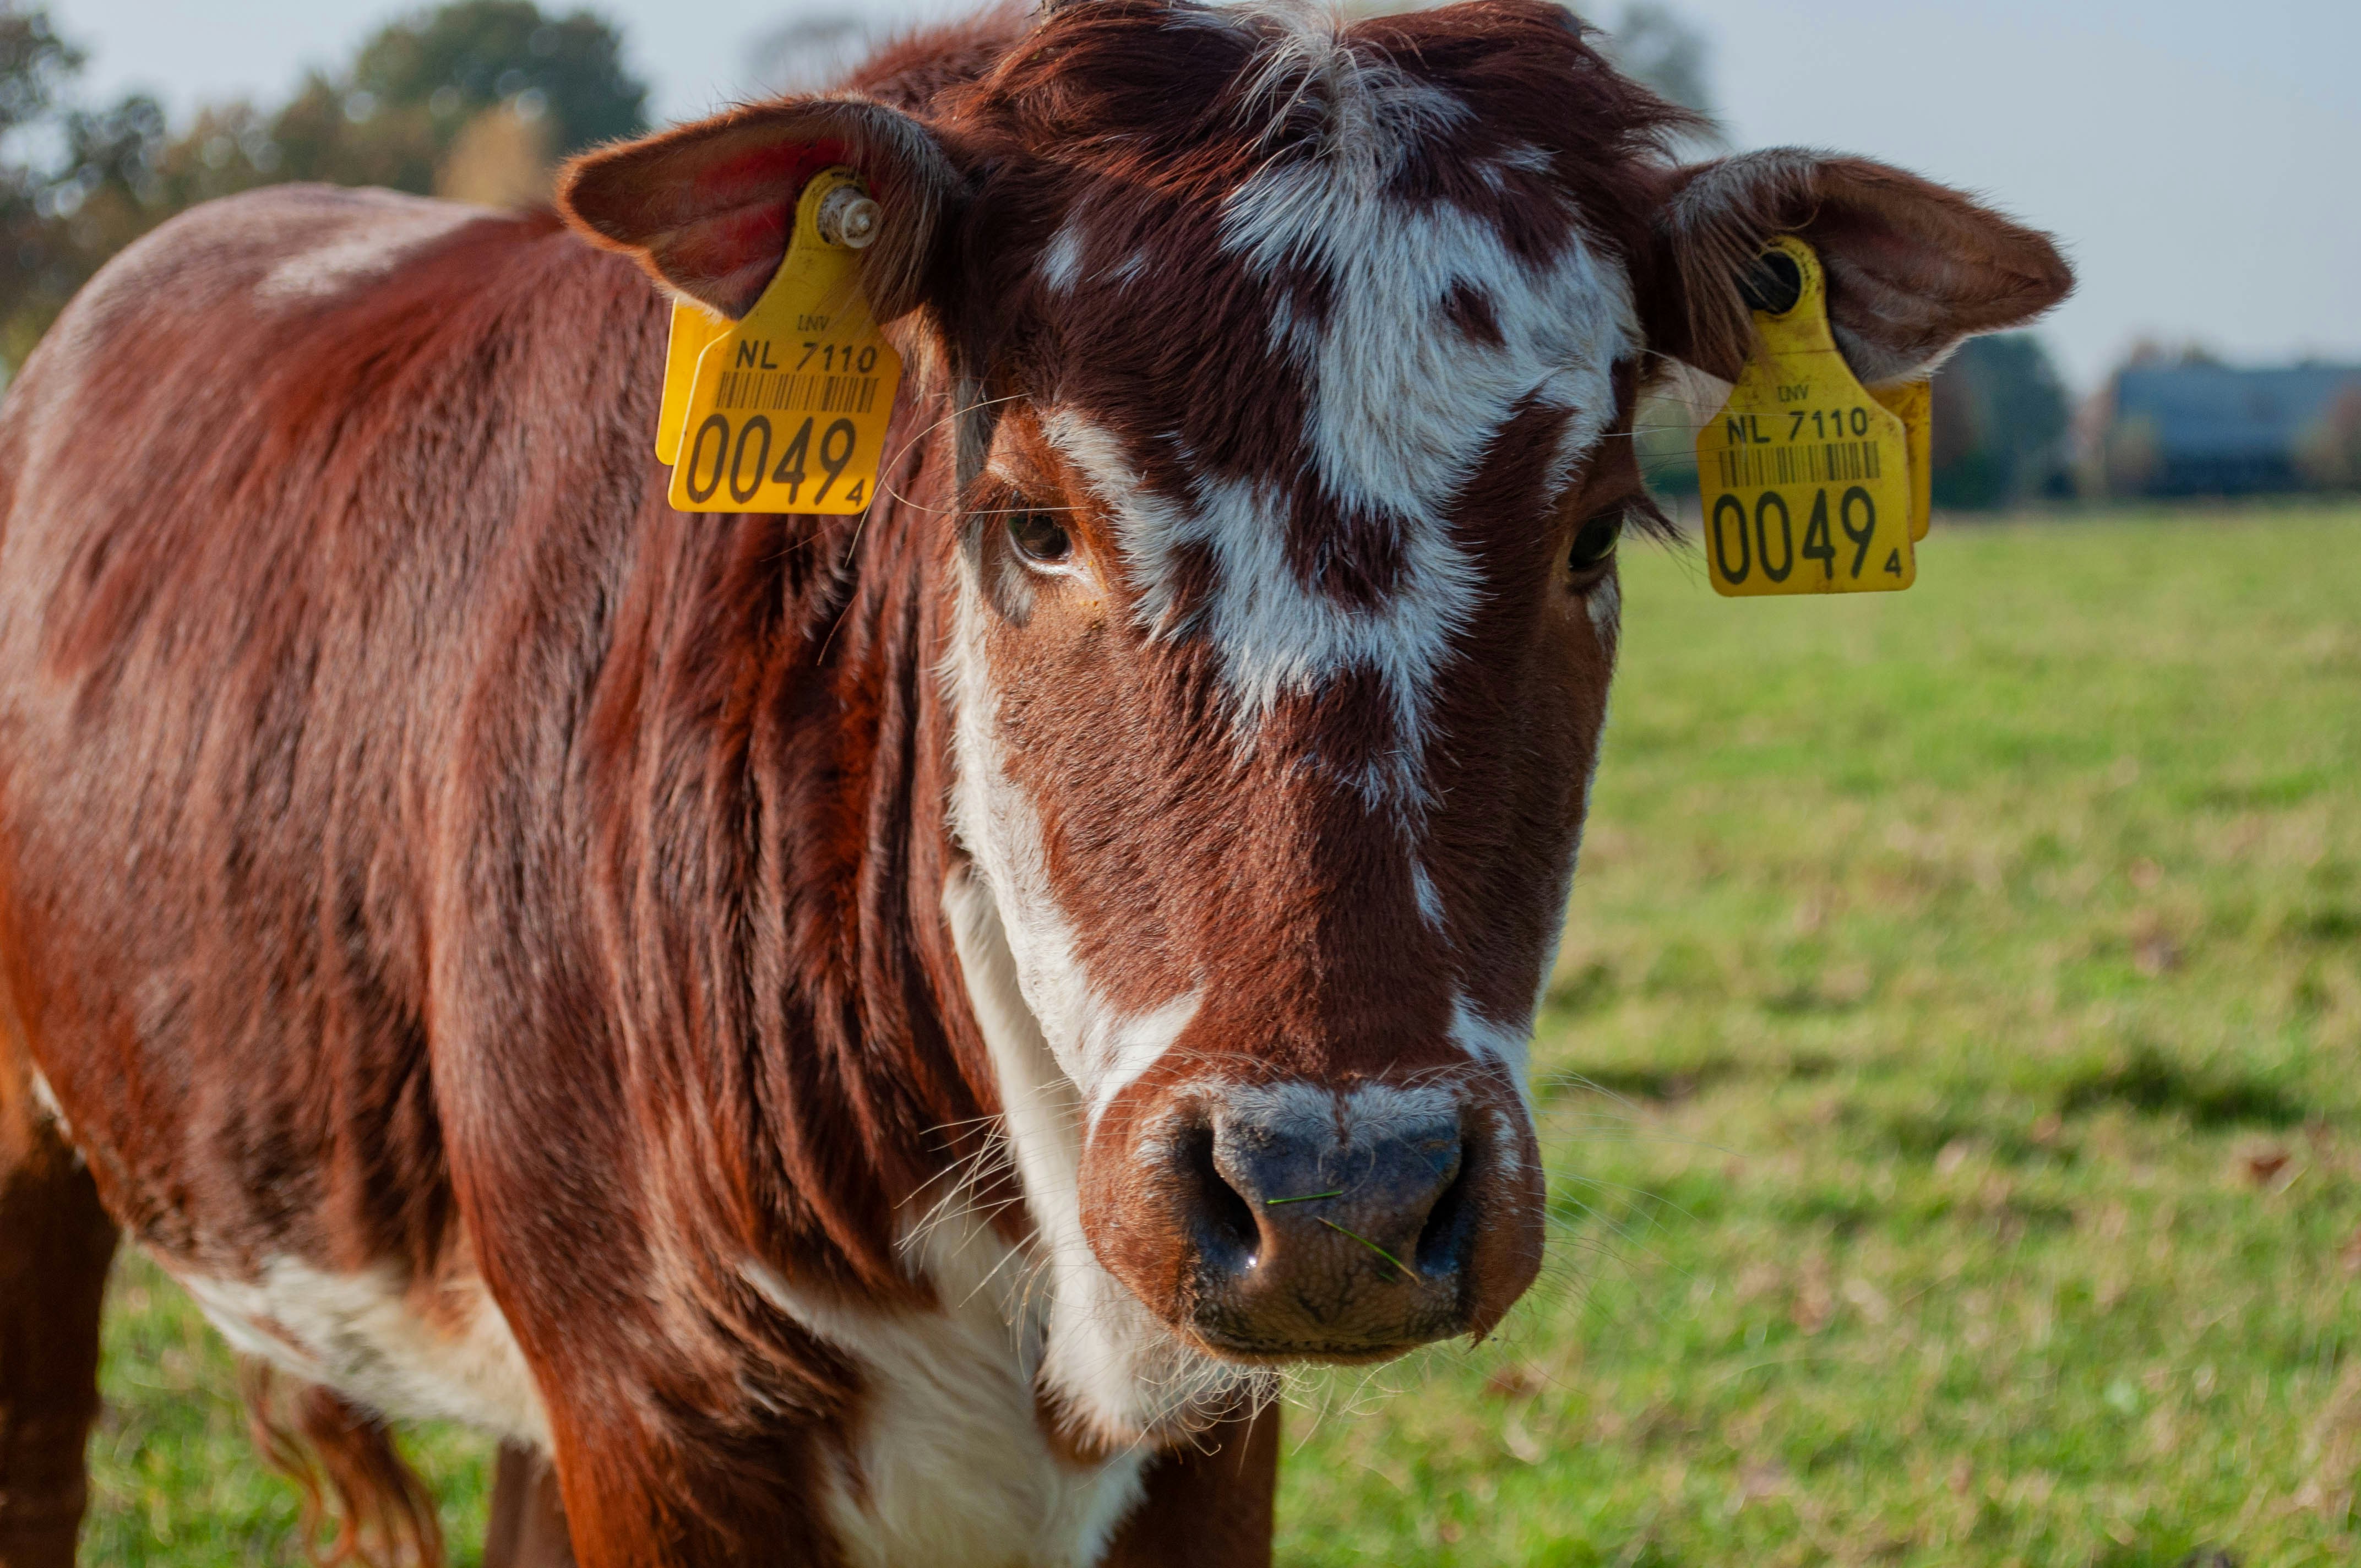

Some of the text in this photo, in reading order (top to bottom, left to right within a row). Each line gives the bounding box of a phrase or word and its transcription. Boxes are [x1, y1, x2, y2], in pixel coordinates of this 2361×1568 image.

[736, 339, 877, 373] NL 7110
[1727, 407, 1868, 444] NL 7110
[687, 413, 865, 506] 0049 4
[1713, 486, 1901, 584] 0049 4
